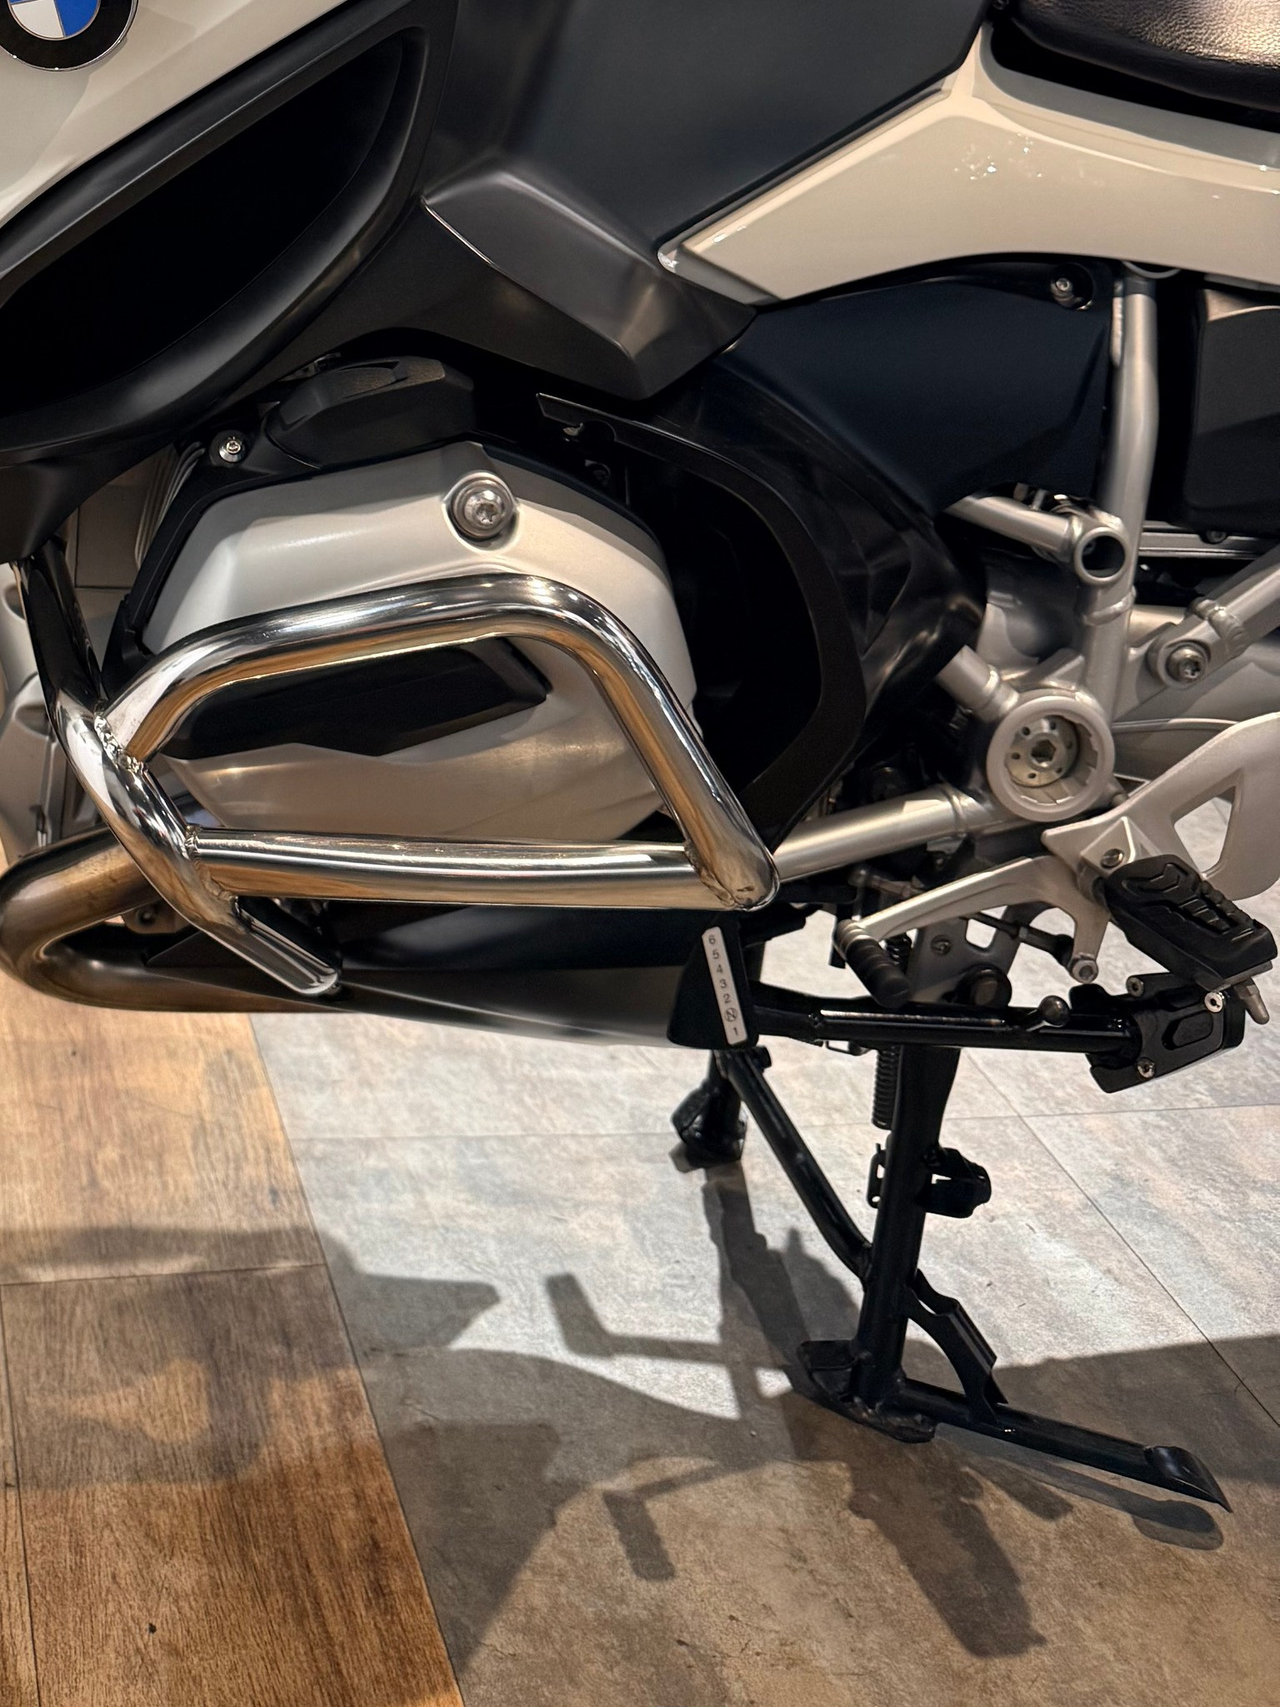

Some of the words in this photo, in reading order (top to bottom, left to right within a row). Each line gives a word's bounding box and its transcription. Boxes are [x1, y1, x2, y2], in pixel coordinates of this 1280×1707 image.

[708, 934, 717, 945] 6
[712, 949, 720, 960] 5
[716, 964, 723, 974] 4
[720, 979, 727, 989] 3
[723, 993, 731, 1004] 2
